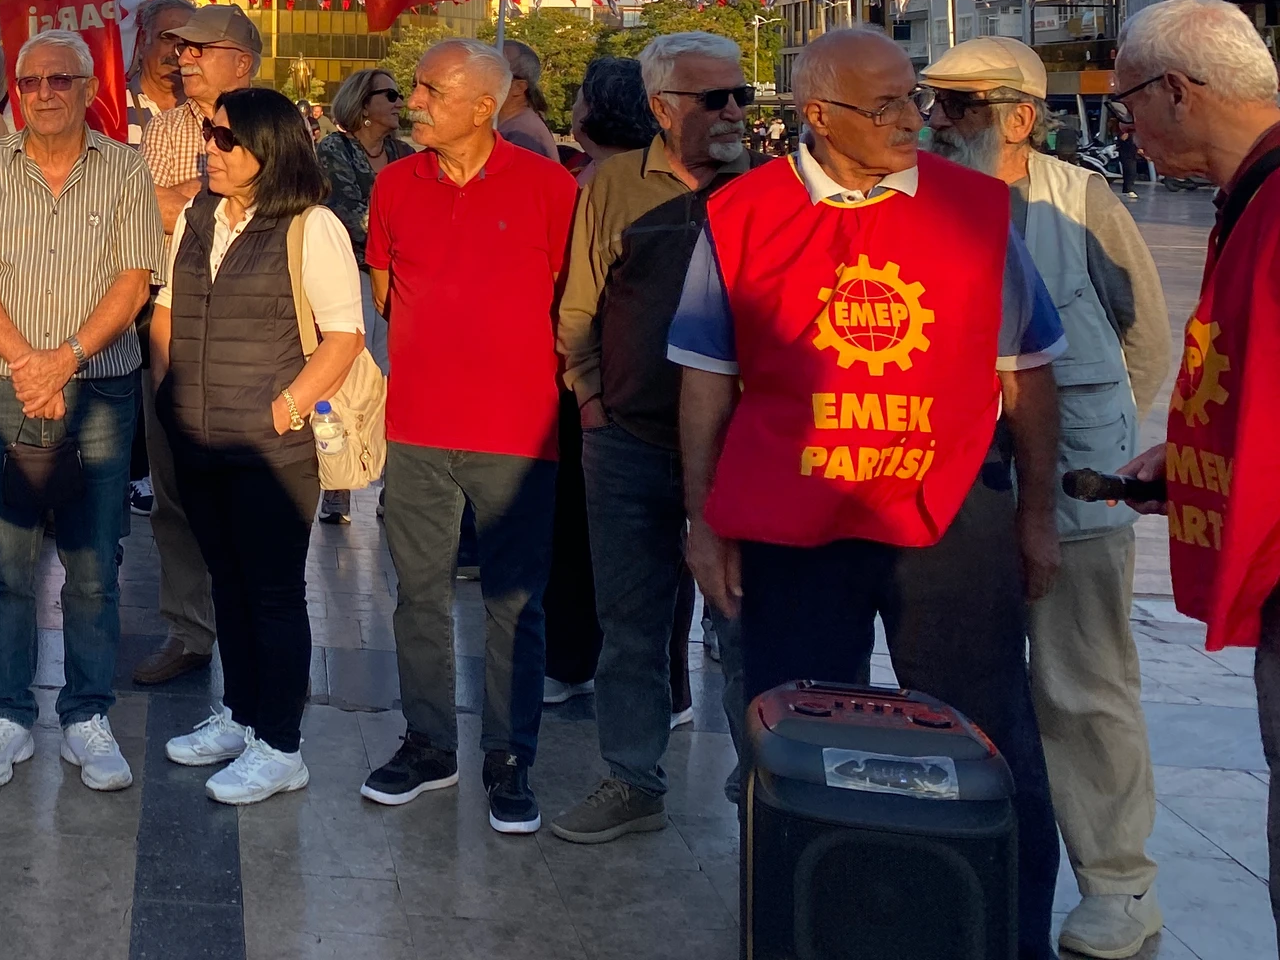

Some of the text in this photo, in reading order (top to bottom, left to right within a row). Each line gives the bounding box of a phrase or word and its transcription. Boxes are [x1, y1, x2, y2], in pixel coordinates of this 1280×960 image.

[834, 301, 909, 327] EMEP
[812, 393, 934, 433] EMEK
[800, 437, 936, 482] PARTİSİ
[1166, 441, 1234, 498] MEK
